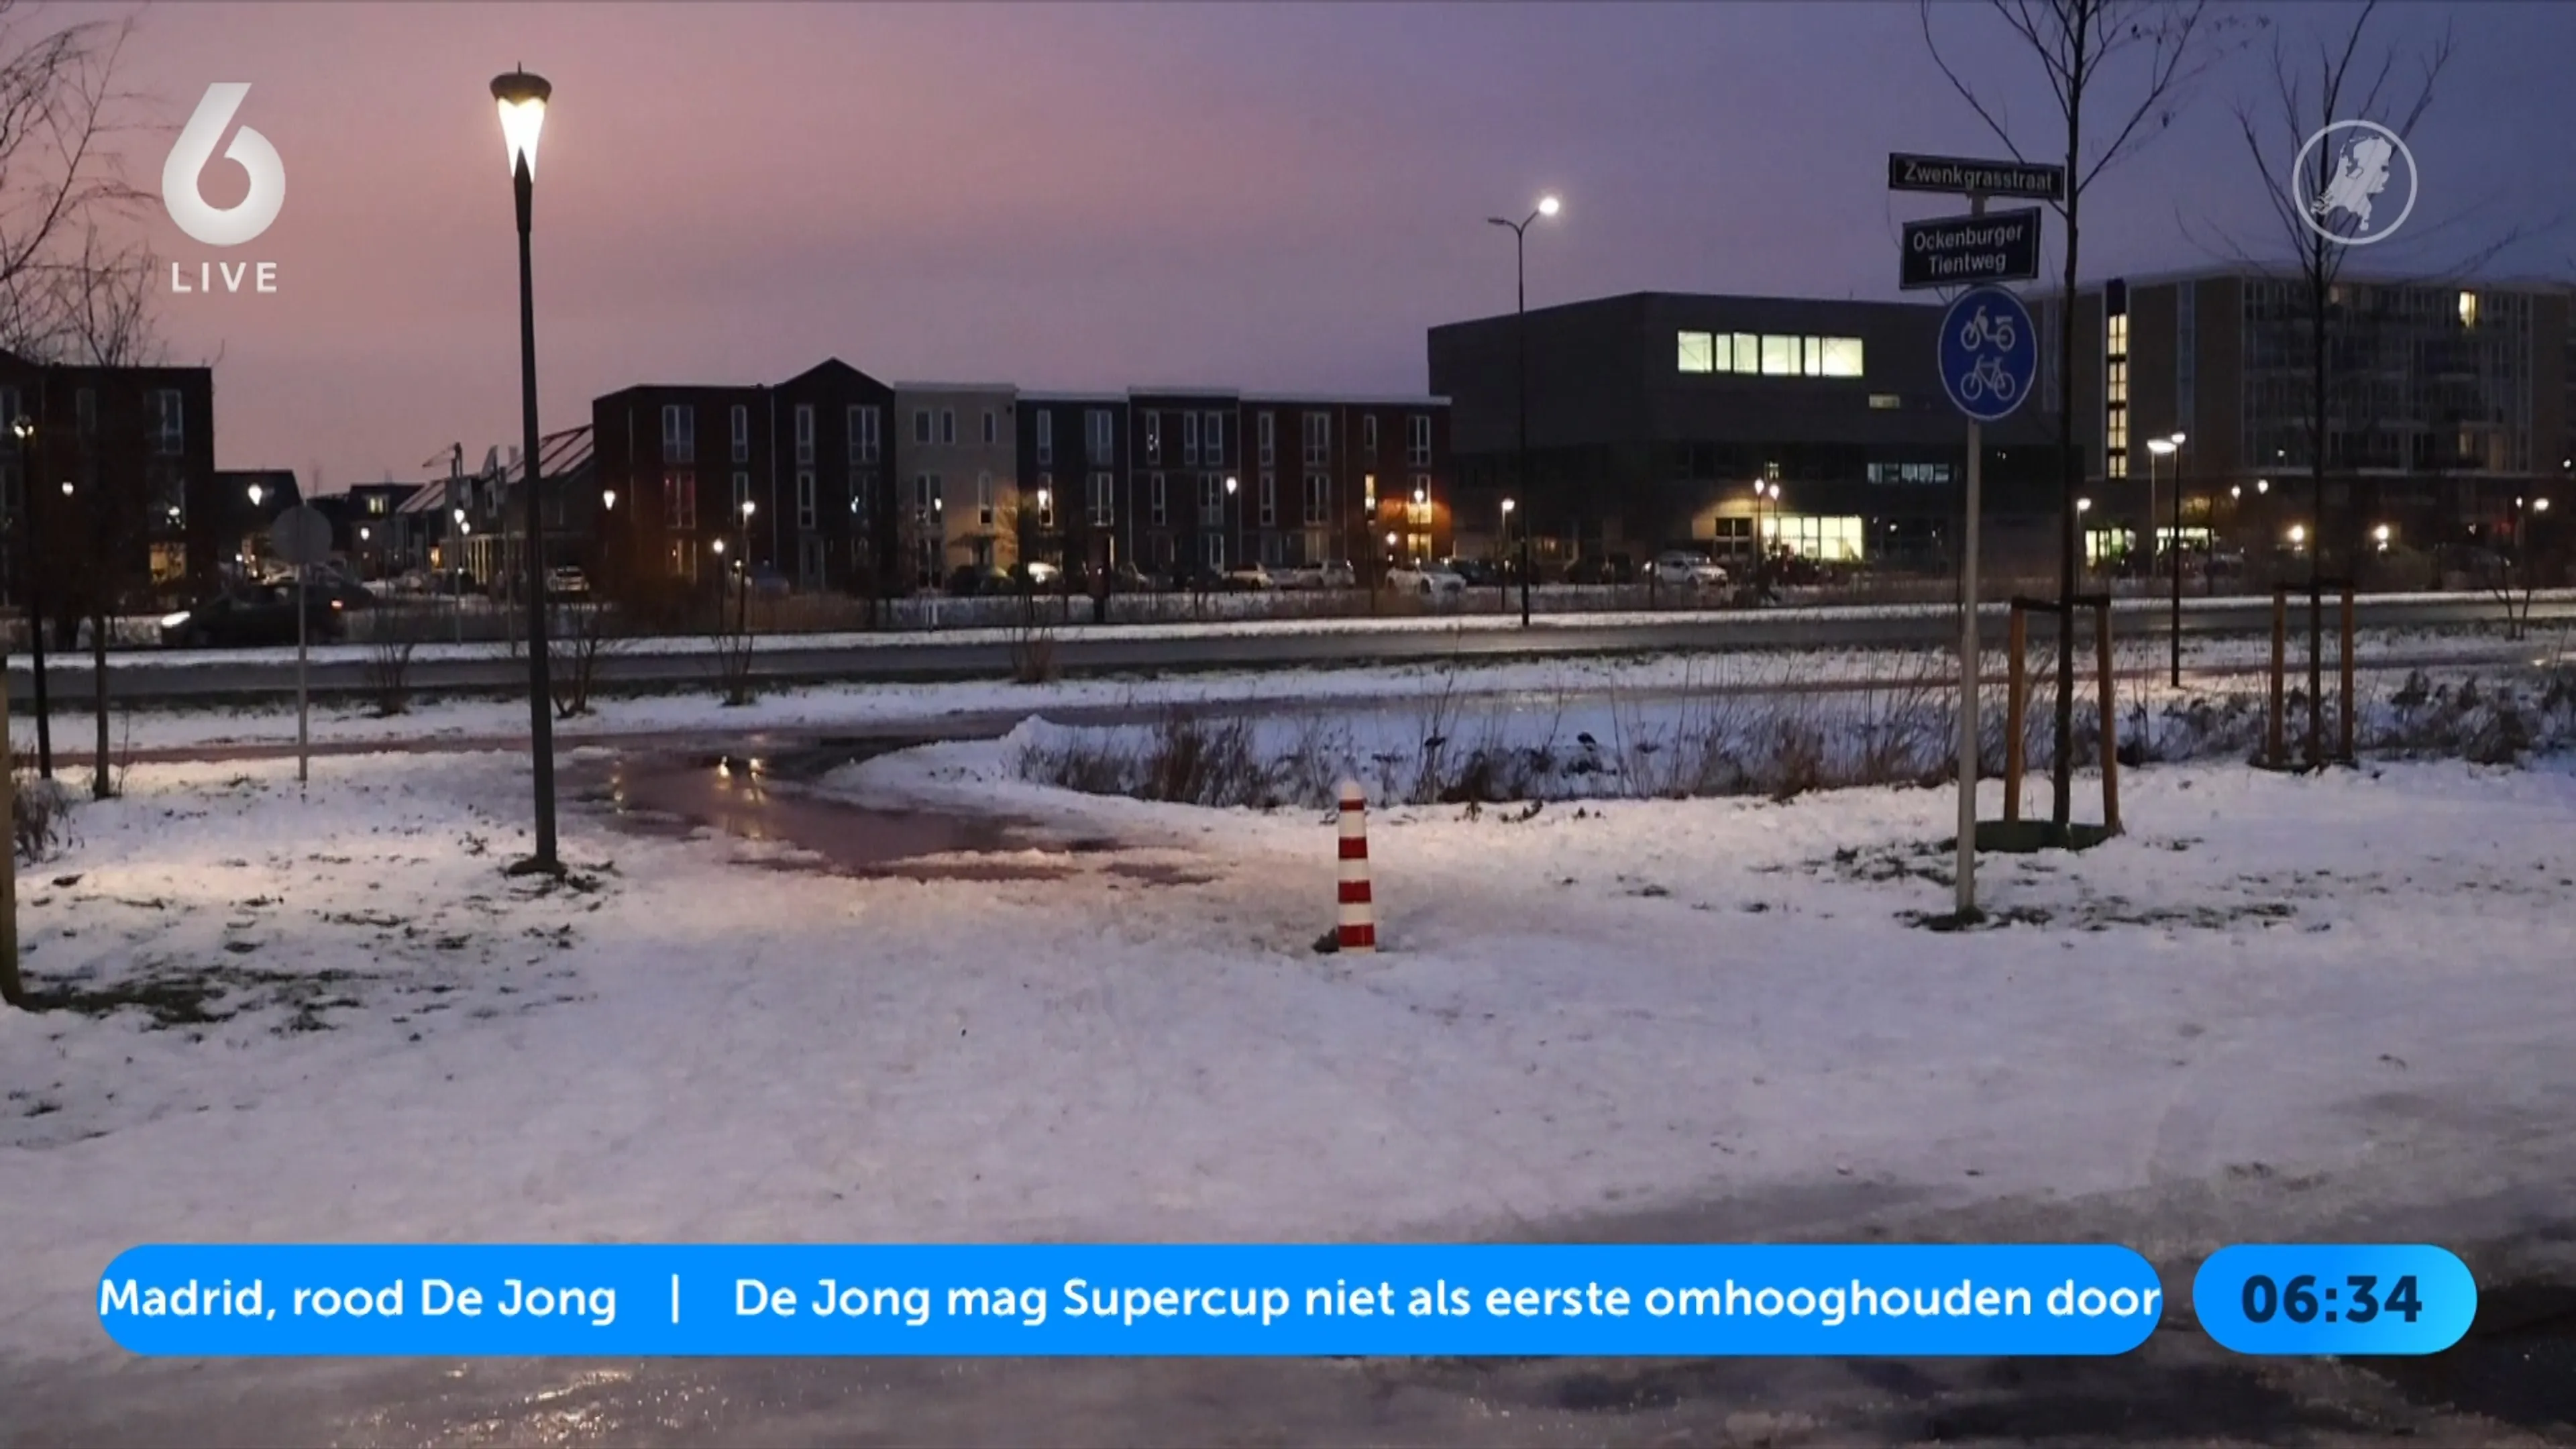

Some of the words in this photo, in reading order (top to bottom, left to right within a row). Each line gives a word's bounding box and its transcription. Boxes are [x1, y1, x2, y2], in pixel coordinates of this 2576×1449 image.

[1904, 160, 2053, 191] Zwenkgrasstraat
[1913, 225, 2023, 252] Ockenburger
[1928, 253, 2007, 274] Tientweg
